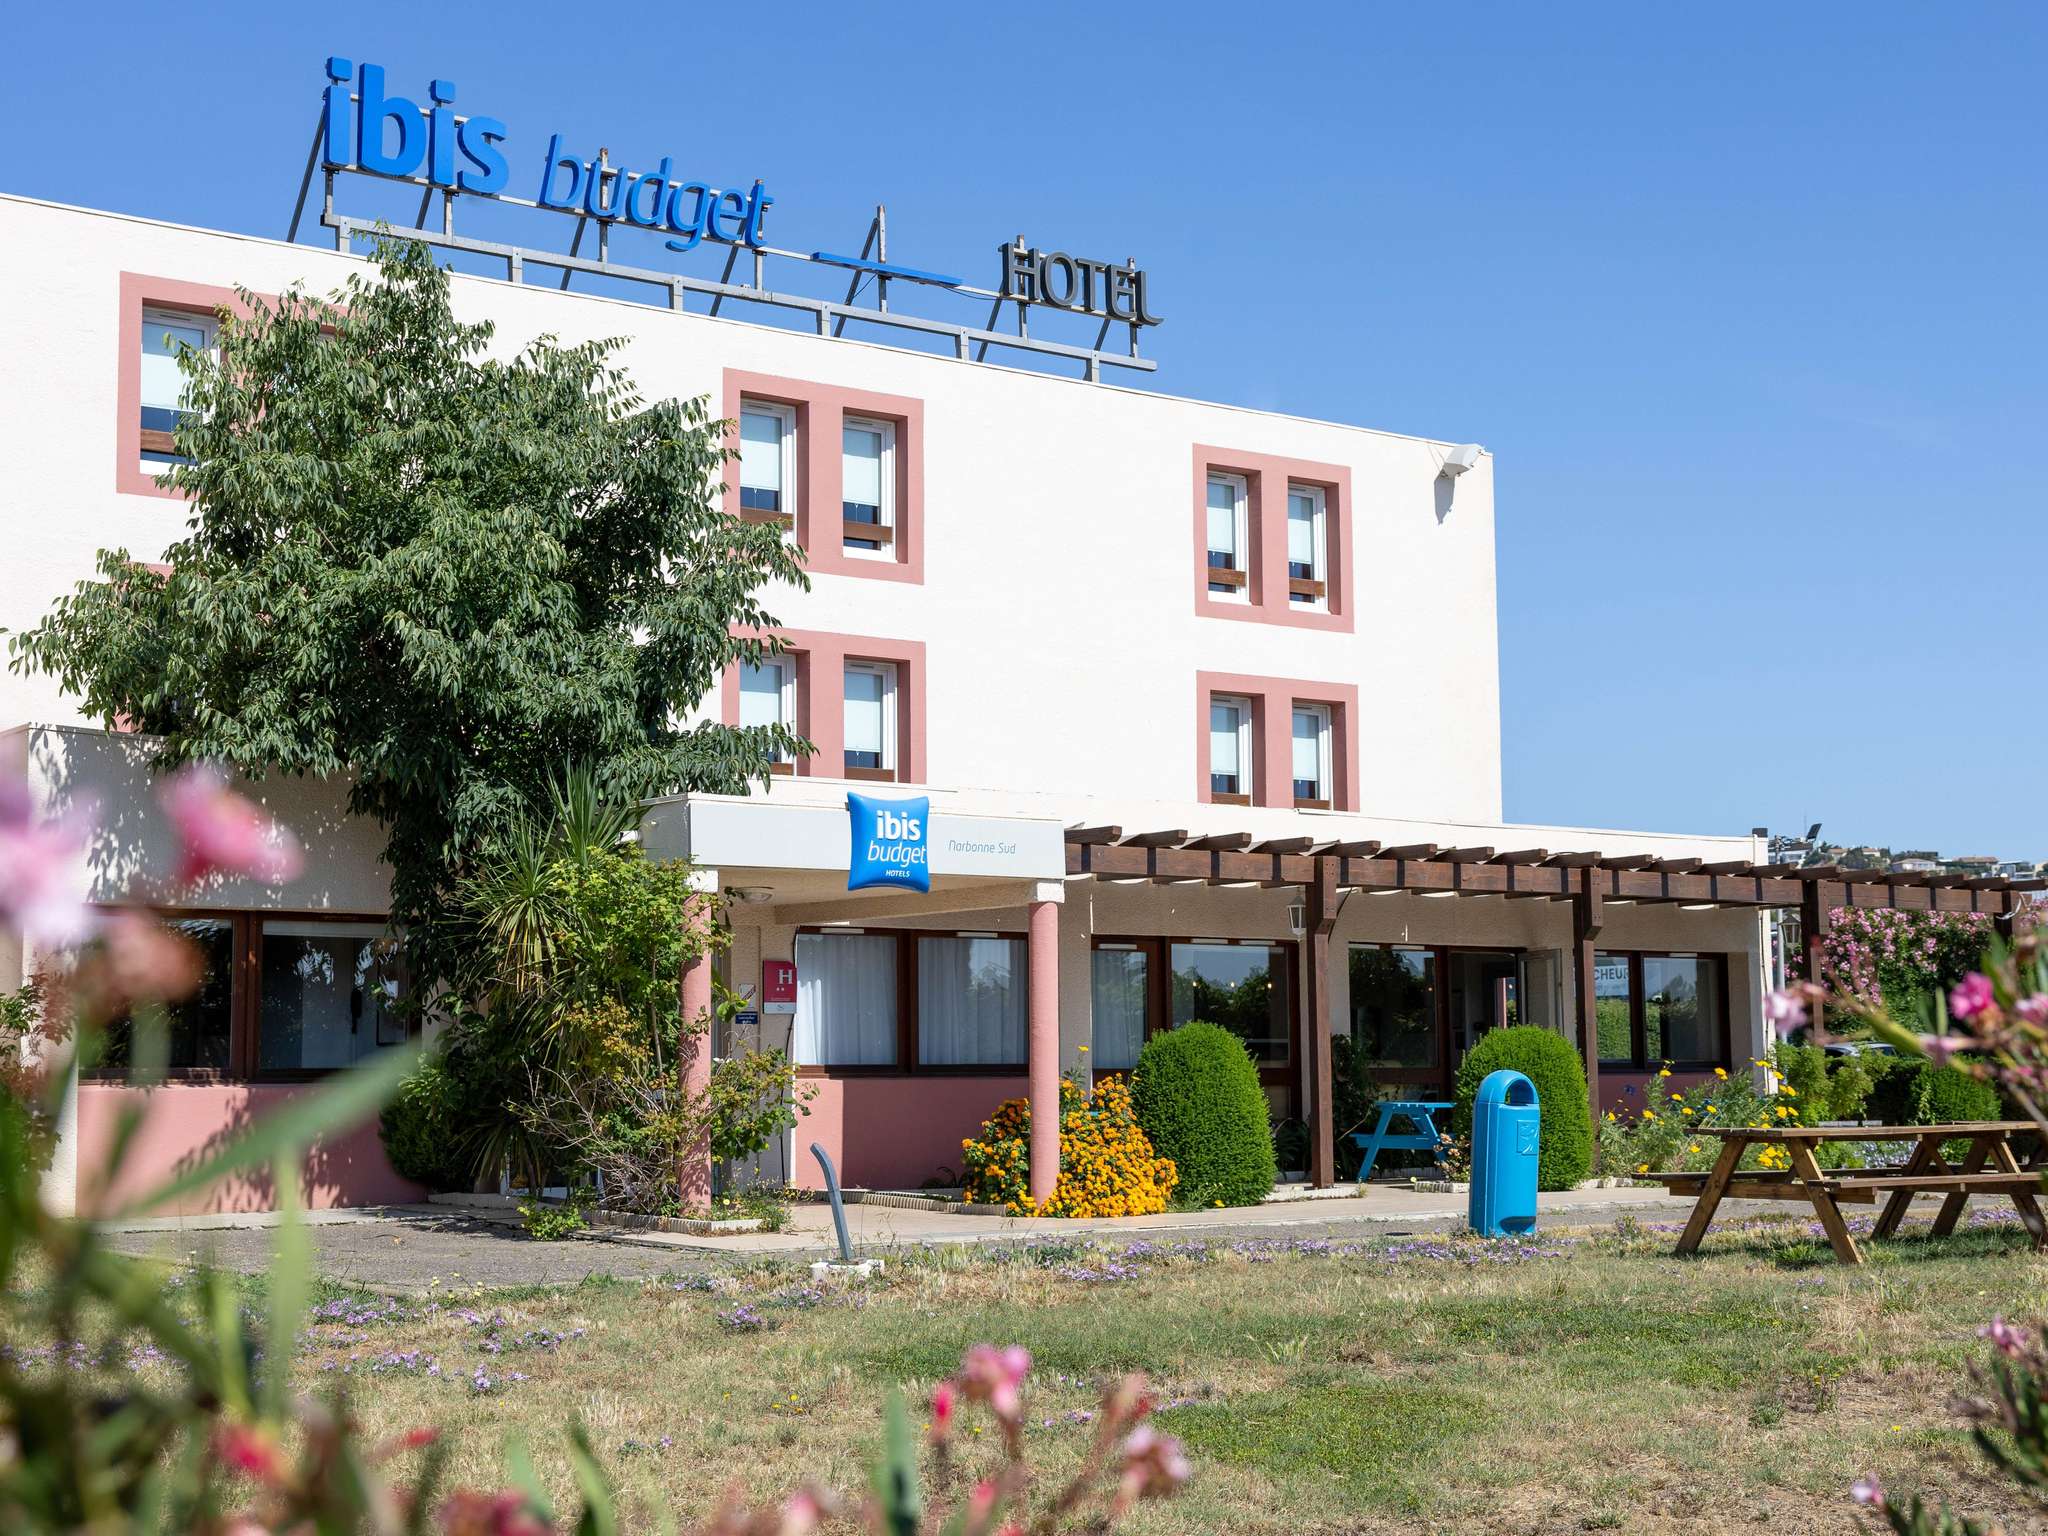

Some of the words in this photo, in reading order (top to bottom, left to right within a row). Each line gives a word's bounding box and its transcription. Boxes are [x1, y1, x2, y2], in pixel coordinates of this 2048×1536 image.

[323, 56, 510, 194] ibis
[538, 133, 774, 252] budget
[1001, 242, 1165, 326] HOTEL
[876, 810, 921, 841] ibis
[867, 840, 927, 867] budget
[948, 840, 995, 854] Narbonne
[998, 842, 1016, 854] Sud
[885, 869, 910, 878] HOTELS
[778, 969, 793, 984] H
